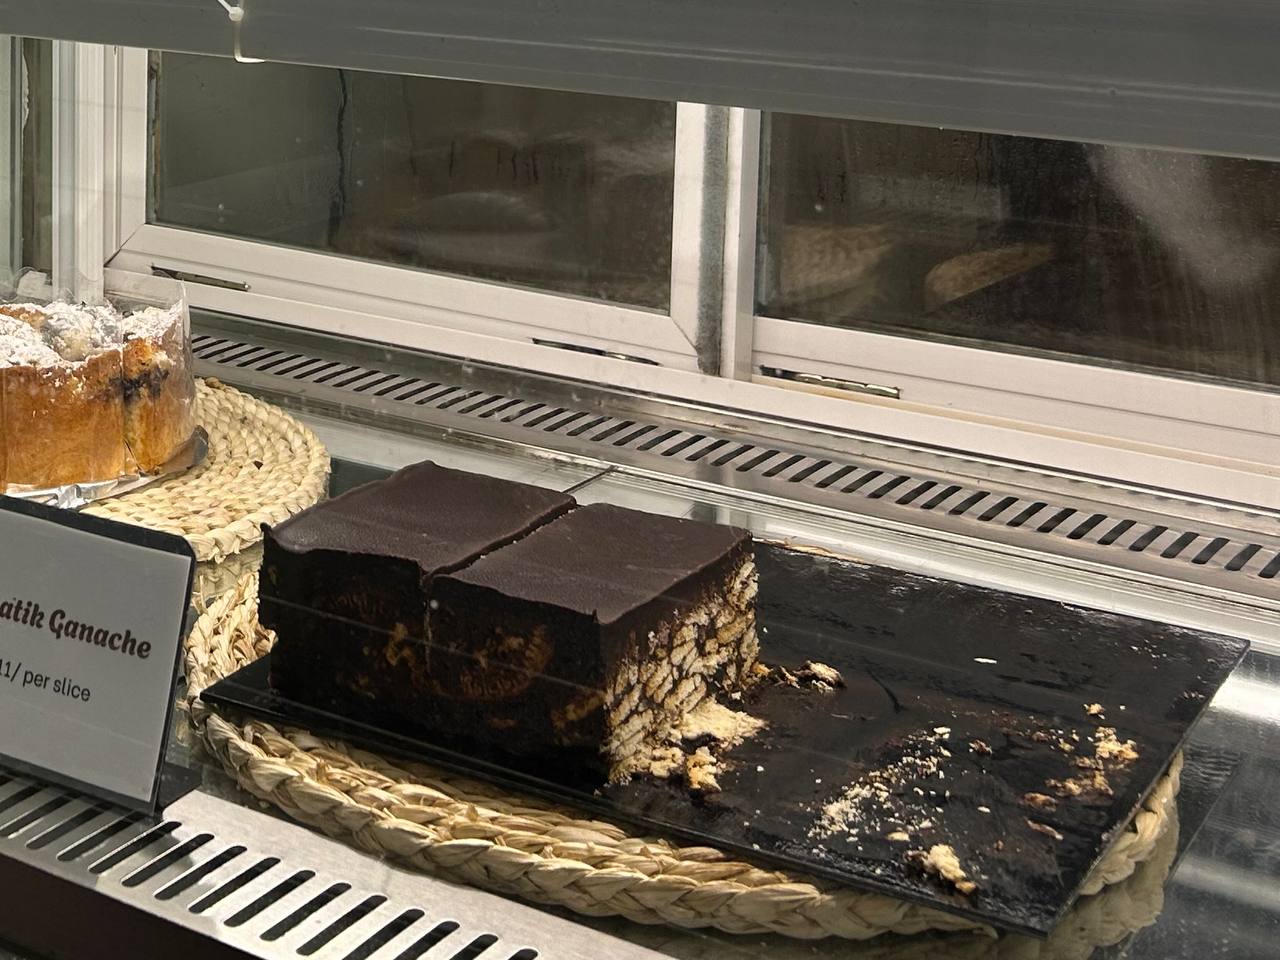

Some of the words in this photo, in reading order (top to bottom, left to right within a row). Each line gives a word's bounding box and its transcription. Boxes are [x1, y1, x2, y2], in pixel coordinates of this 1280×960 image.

[48, 609, 152, 659] Ganache
[22, 668, 51, 688] per
[53, 677, 91, 702] slice
